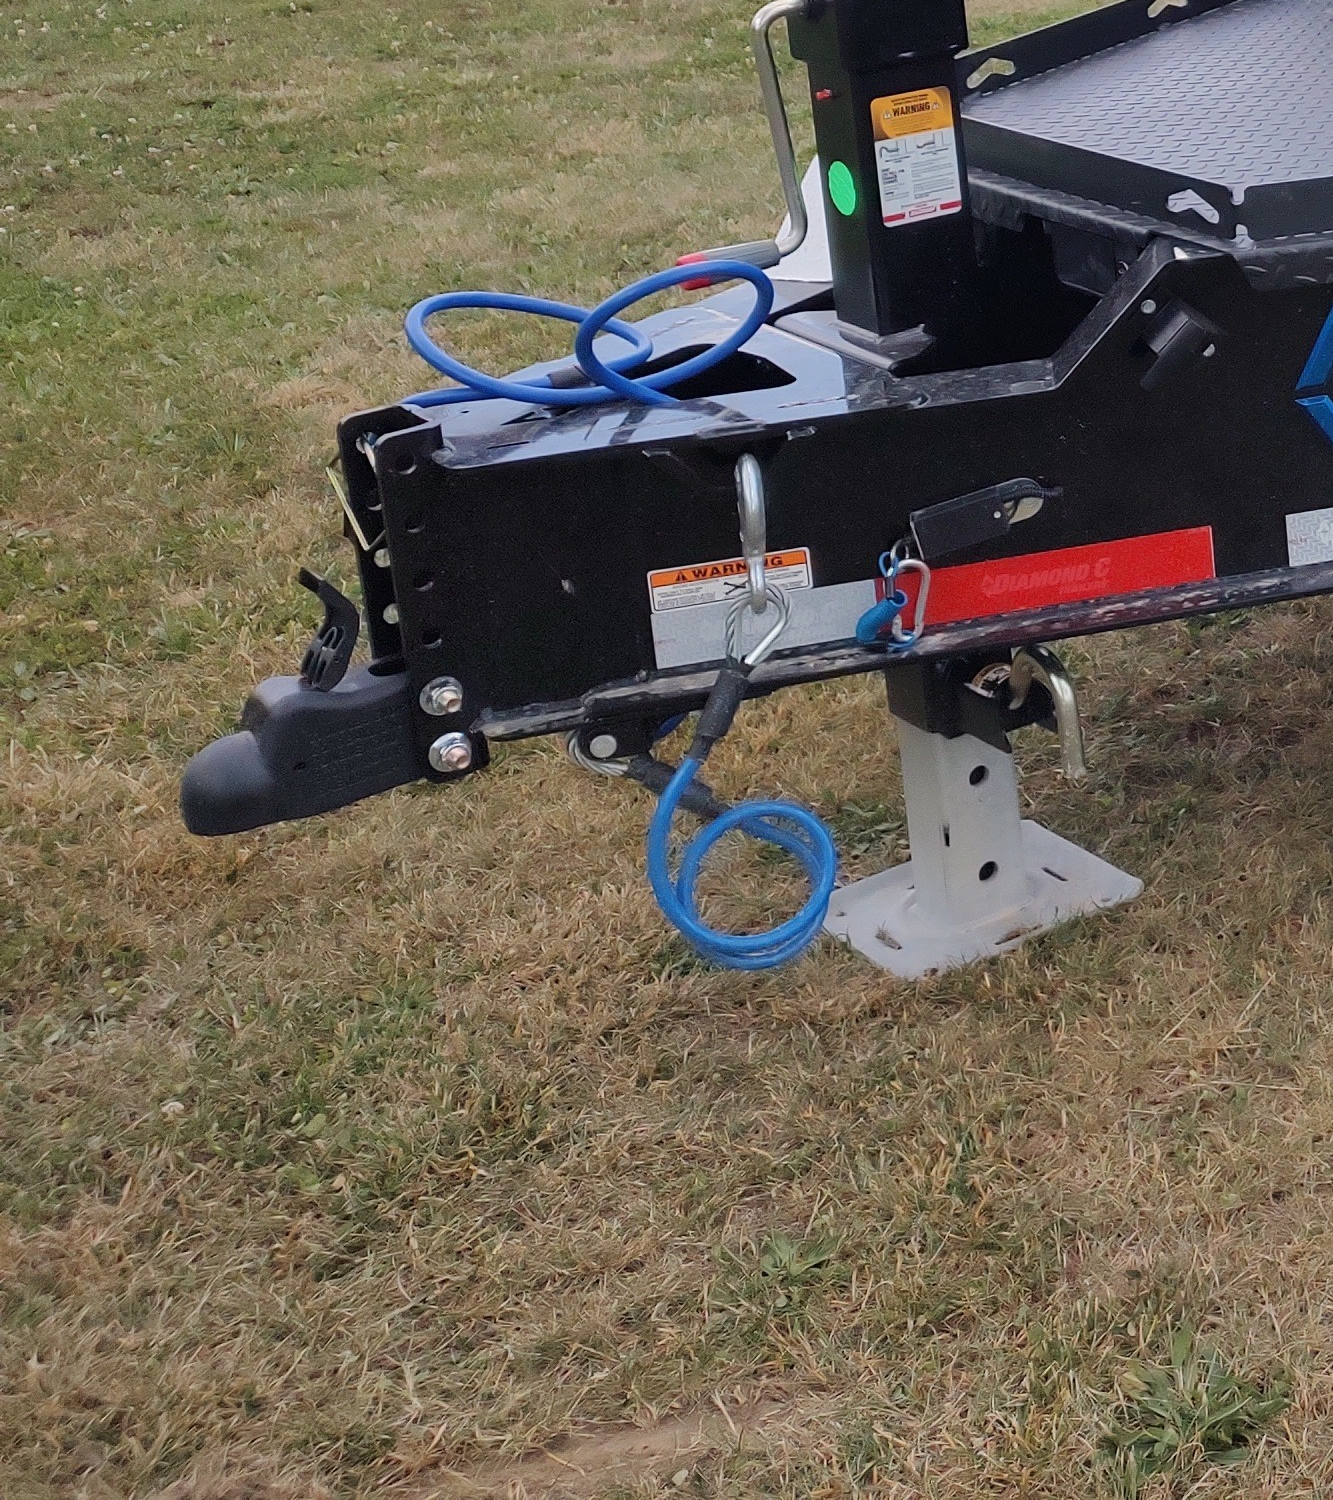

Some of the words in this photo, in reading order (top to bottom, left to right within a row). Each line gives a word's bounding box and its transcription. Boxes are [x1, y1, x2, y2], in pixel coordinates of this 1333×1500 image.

[891, 101, 932, 118] WARNING
[692, 555, 784, 579] WARNG
[991, 563, 1090, 595] DIAMOND
